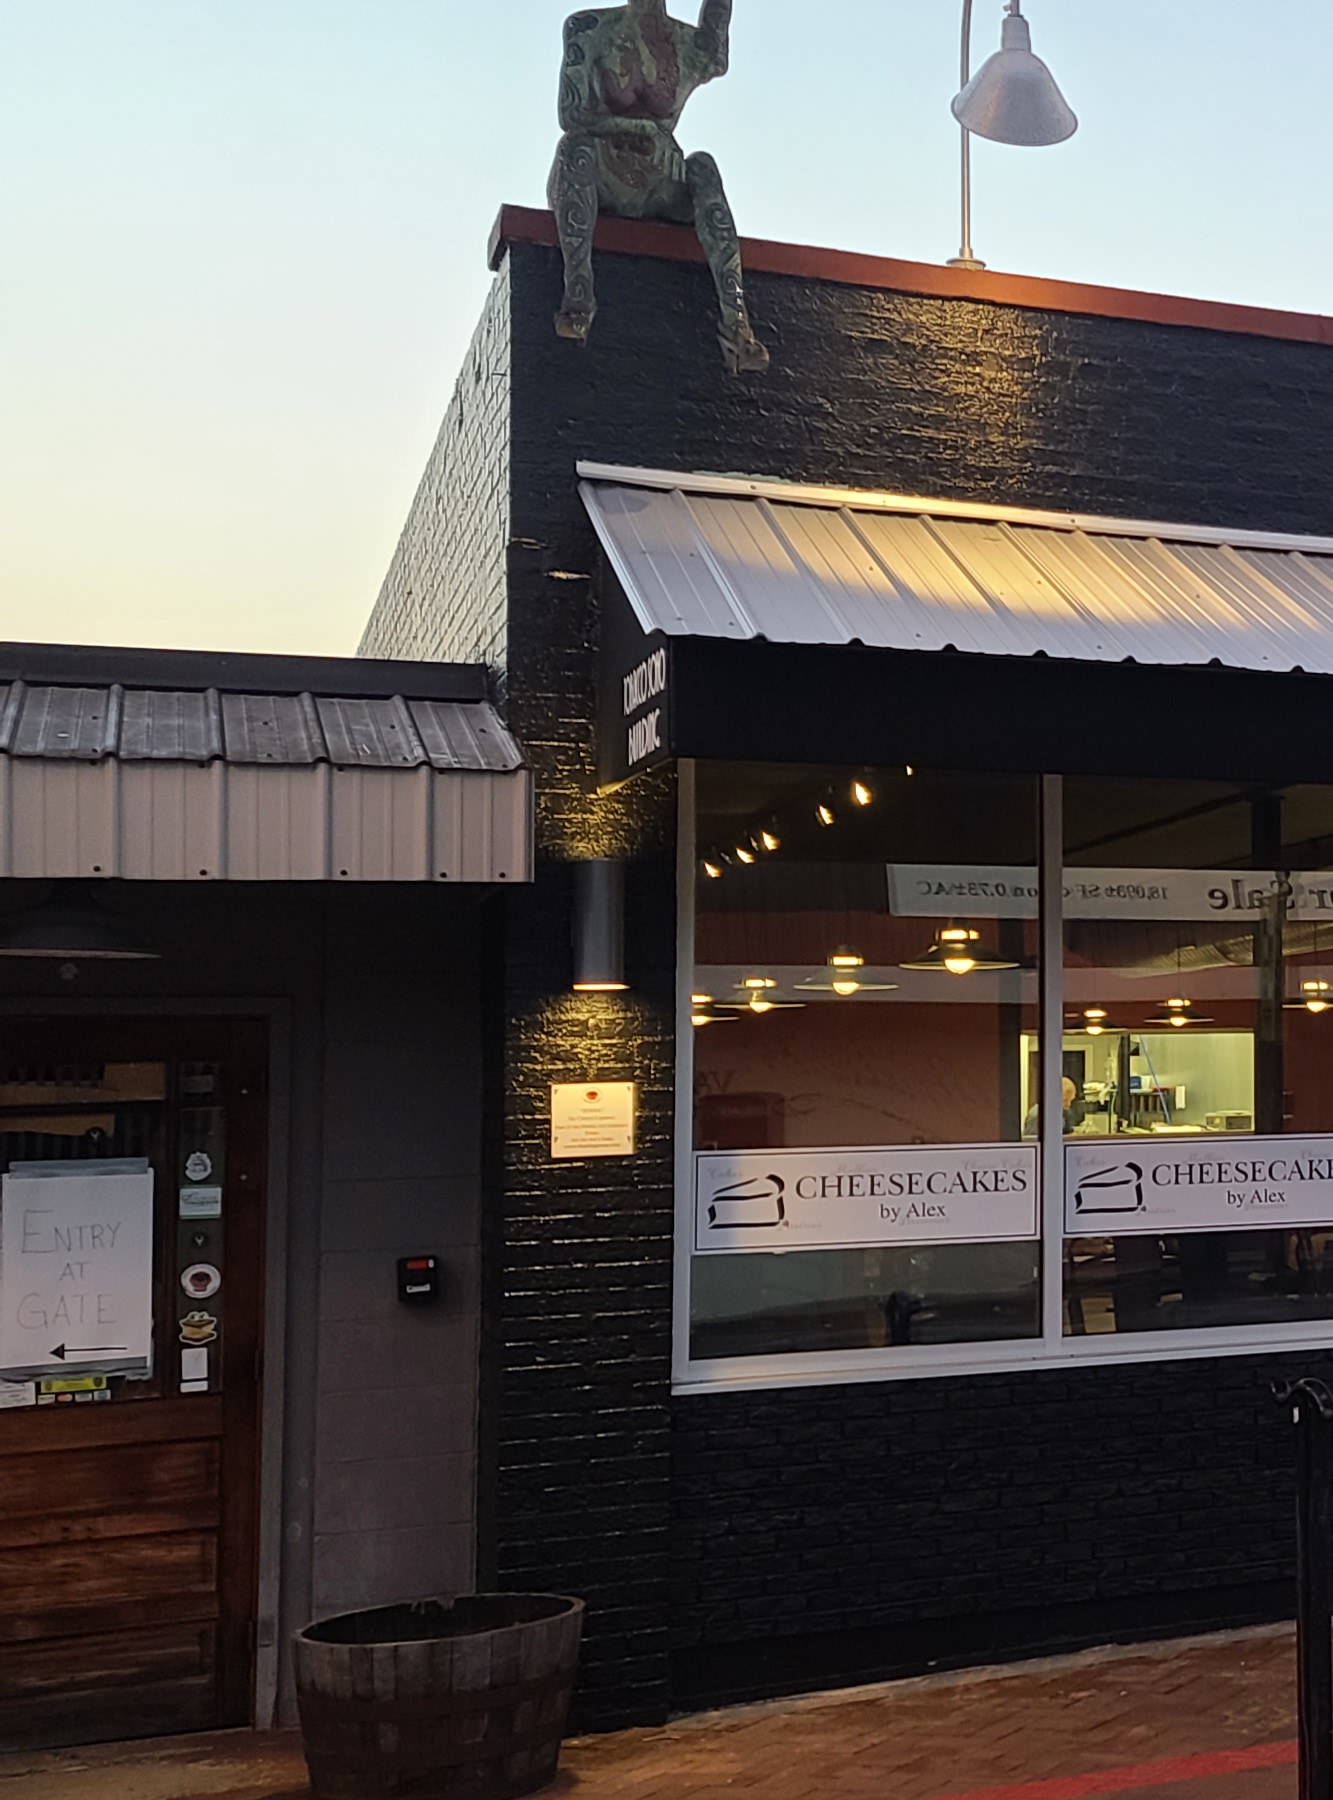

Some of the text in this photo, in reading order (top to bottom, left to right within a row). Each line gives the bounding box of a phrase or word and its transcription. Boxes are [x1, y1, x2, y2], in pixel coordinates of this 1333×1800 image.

[795, 1168, 1028, 1200] CHEESECAKES
[1226, 1188, 1286, 1208] by Alex
[879, 1202, 946, 1223] by Alex
[21, 1209, 122, 1254] ENTRY
[59, 1261, 91, 1281] AT
[16, 1292, 119, 1330] GATE
